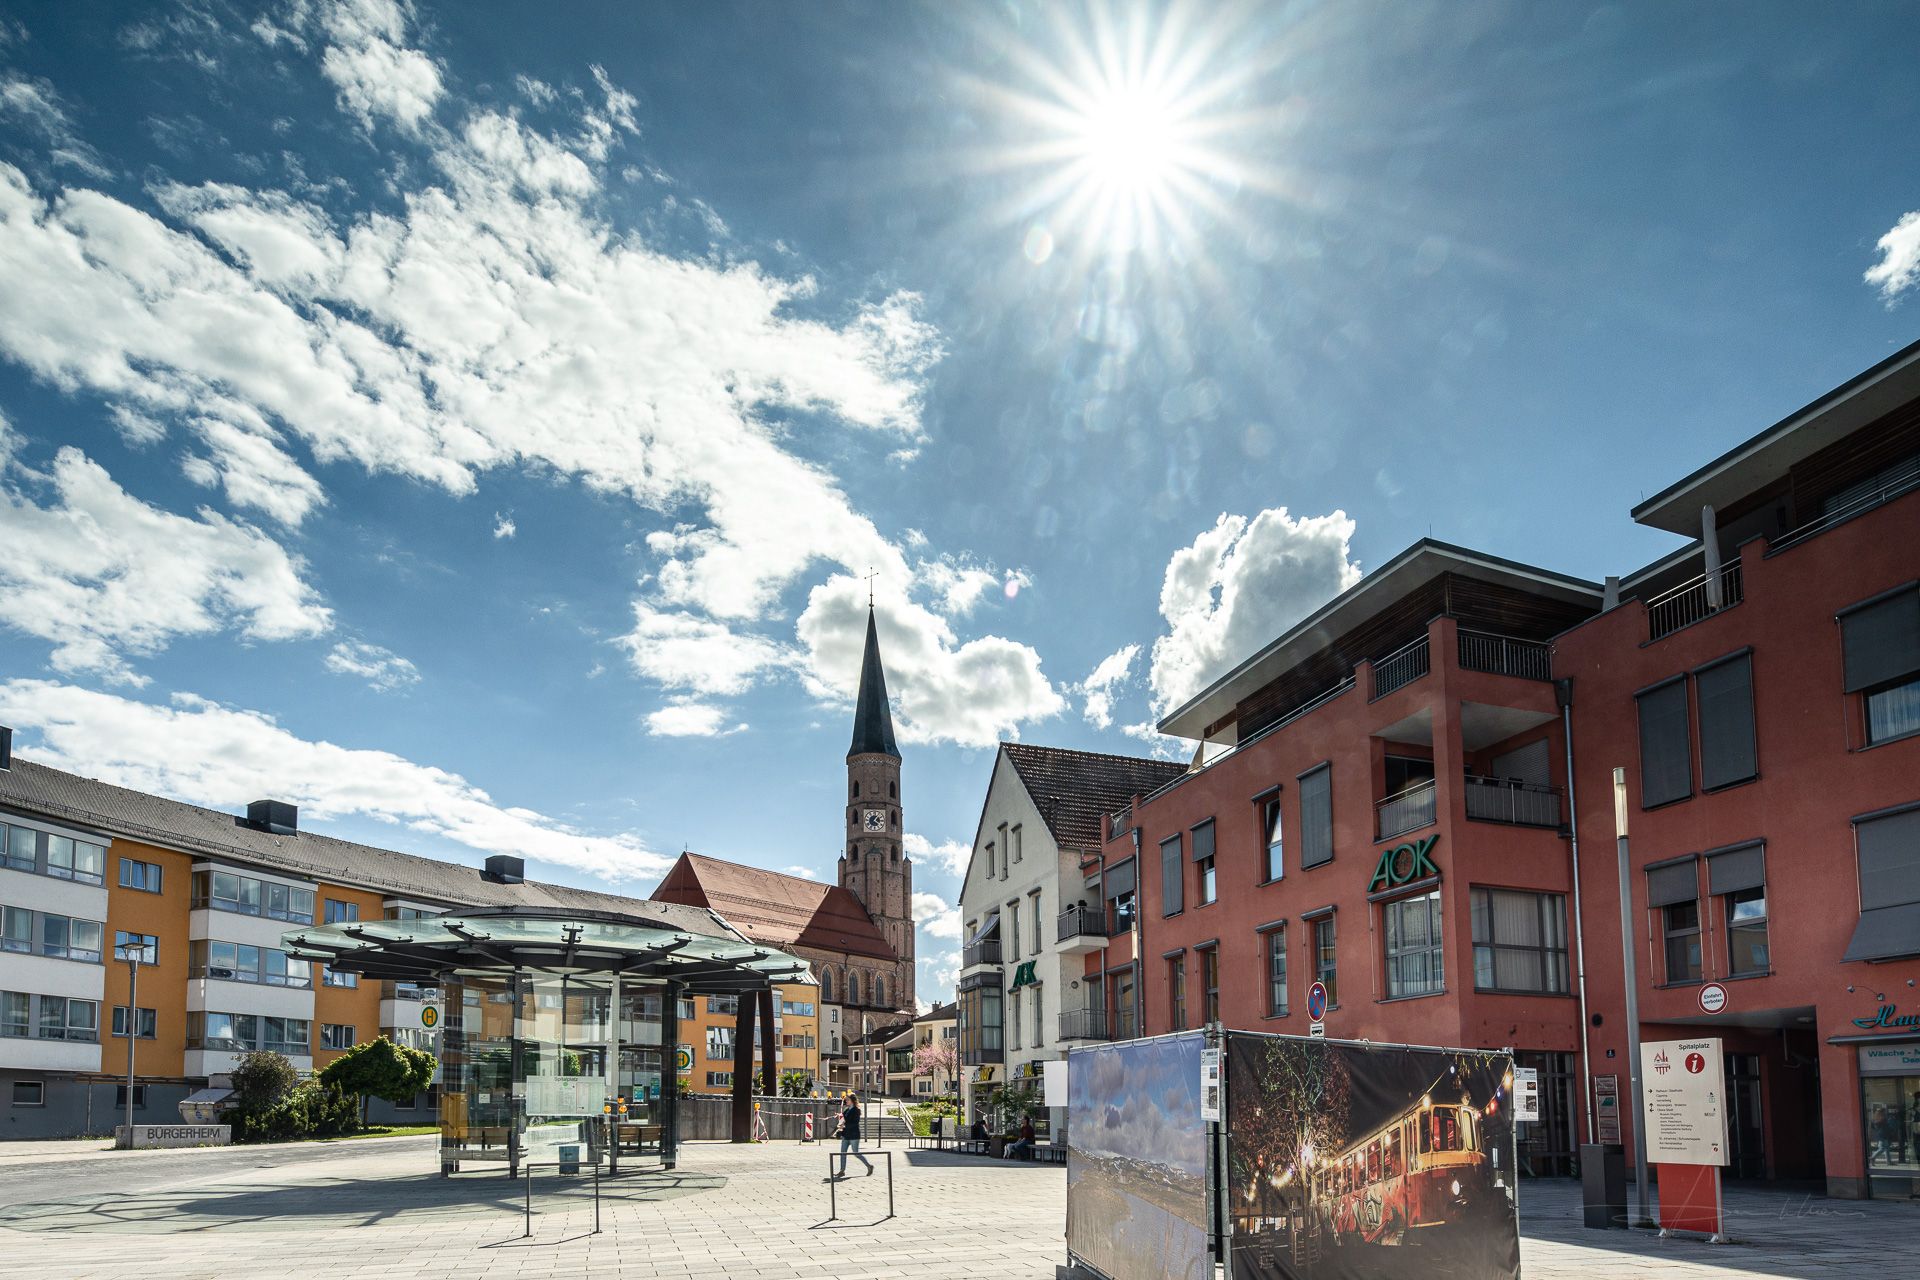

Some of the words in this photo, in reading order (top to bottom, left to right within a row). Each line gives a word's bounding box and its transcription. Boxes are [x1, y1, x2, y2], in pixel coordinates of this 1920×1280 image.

[1367, 834, 1441, 892] AOK
[1013, 959, 1038, 988] AOK
[1678, 1043, 1710, 1051] Spitalplatz
[147, 1126, 220, 1139] BÜRGERHEIM
